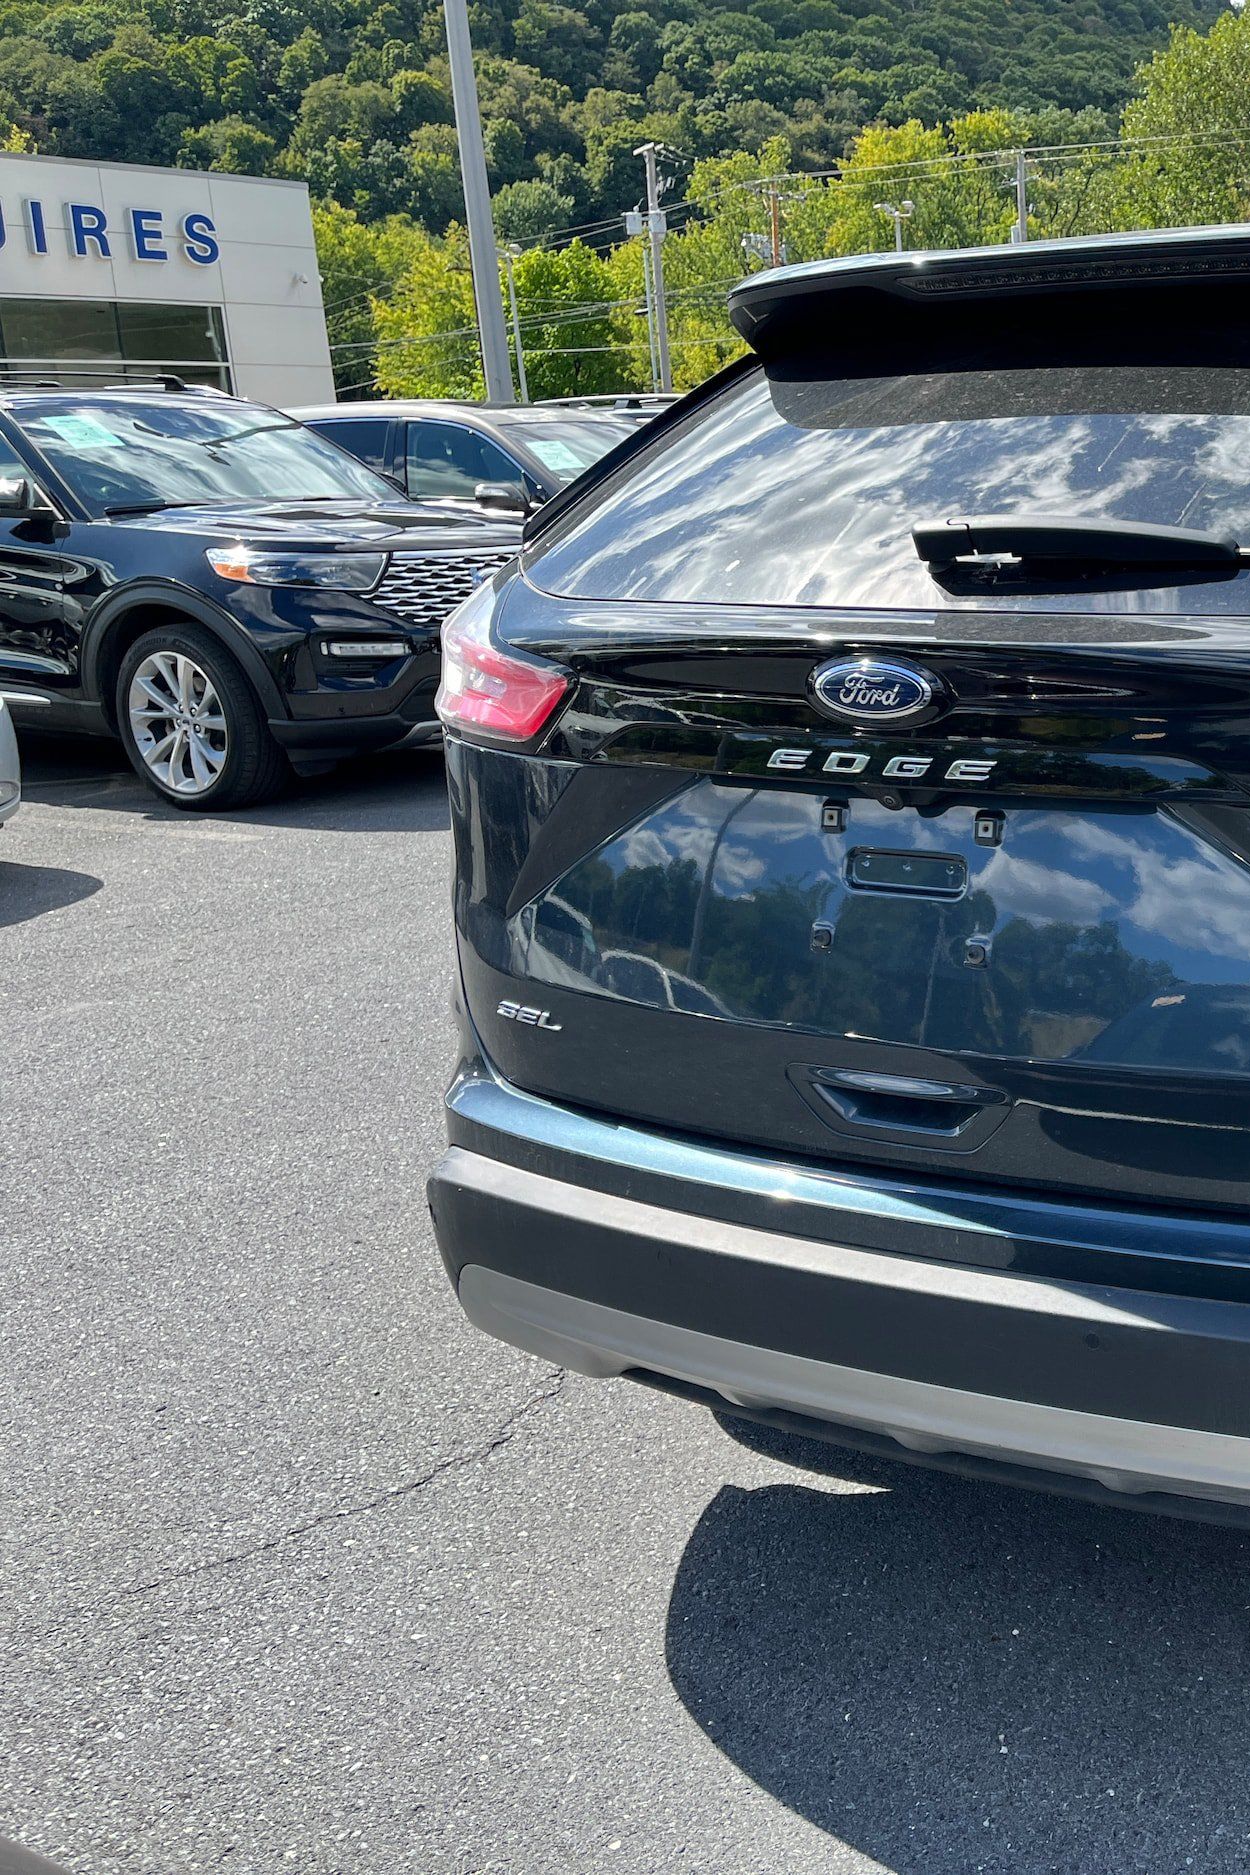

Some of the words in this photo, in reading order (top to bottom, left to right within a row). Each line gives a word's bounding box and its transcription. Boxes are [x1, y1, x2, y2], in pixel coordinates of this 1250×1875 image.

[839, 673, 901, 706] Ford
[766, 748, 998, 782] EDGE
[497, 1000, 562, 1031] SEL
